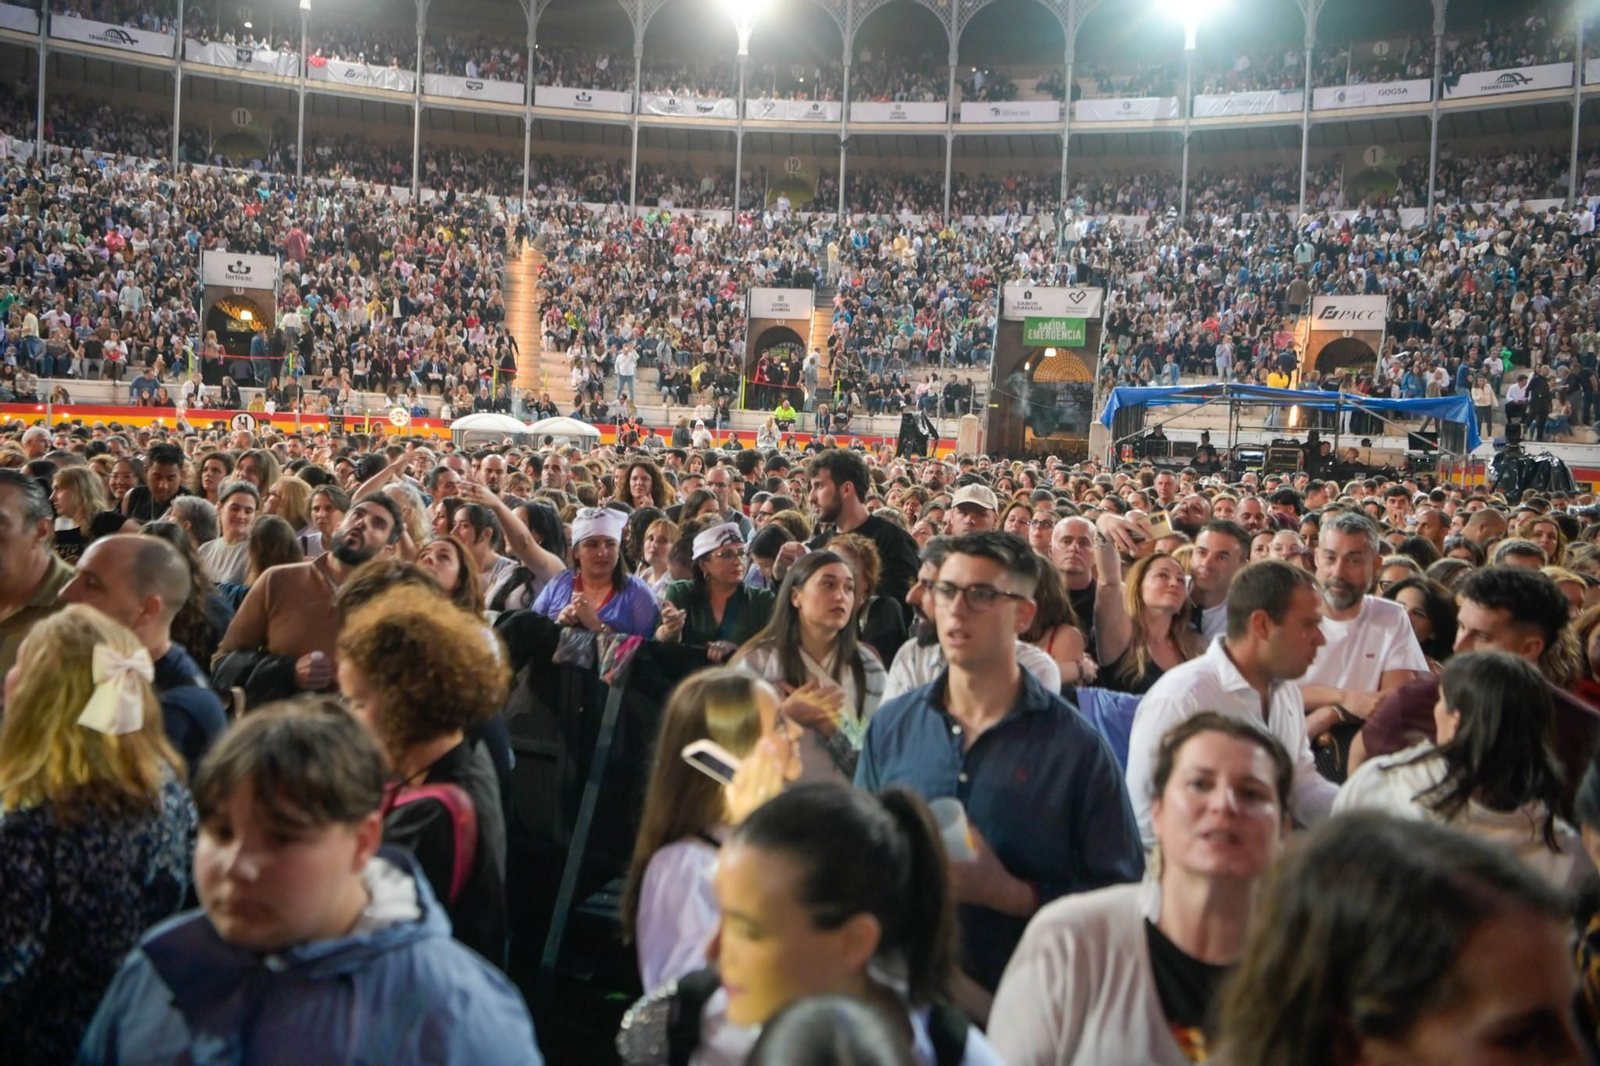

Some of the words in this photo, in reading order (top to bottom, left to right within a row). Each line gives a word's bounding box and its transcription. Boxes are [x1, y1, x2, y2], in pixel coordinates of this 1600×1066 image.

[1378, 88, 1408, 96] GOGSA
[788, 159, 799, 171] 12
[225, 273, 253, 282] fertisac
[1338, 310, 1381, 320] PACC
[1027, 330, 1082, 340] EMERGENCIA
